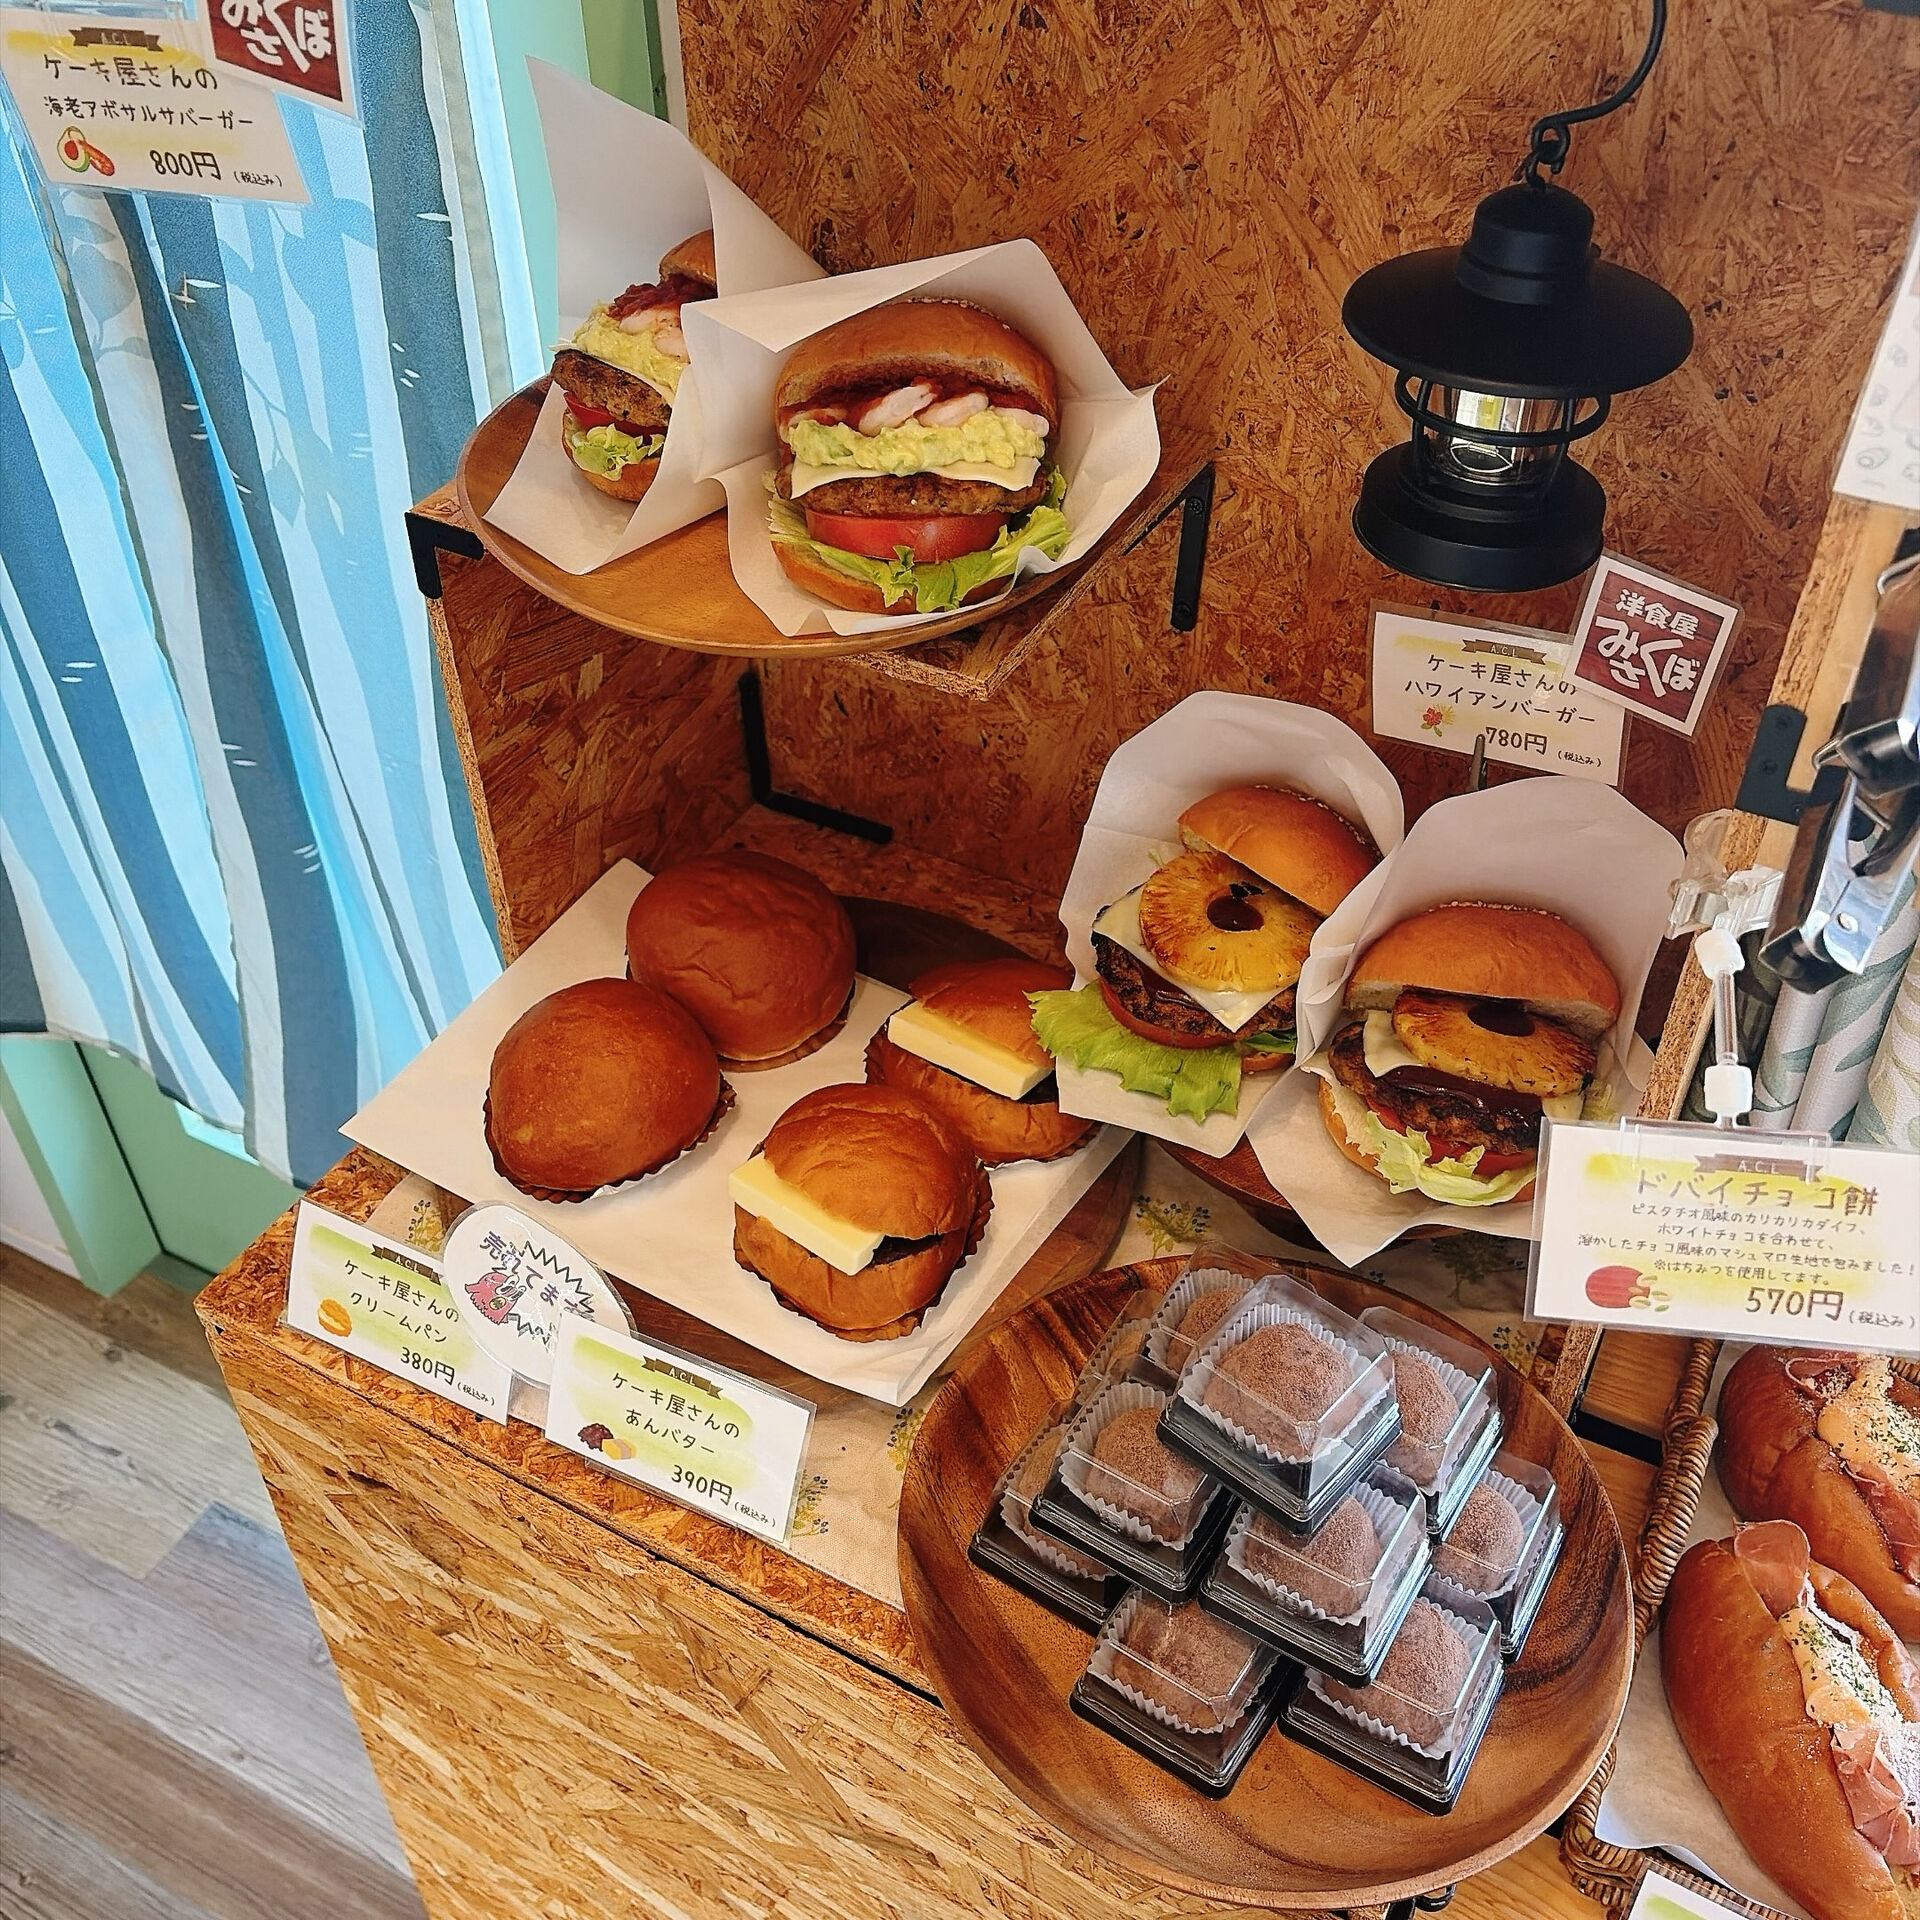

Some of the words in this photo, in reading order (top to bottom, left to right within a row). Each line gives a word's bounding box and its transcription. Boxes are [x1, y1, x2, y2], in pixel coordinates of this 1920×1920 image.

[43, 54, 218, 90] ケーキ屋さんの
[43, 95, 254, 130] 海老アボサルサバーガー
[150, 149, 222, 181] 800円
[233, 170, 283, 188] (税込み)
[1615, 588, 1699, 640] 洋食屋
[1427, 653, 1577, 696] ケーキ屋さんの
[1404, 680, 1596, 724] ハワイアンバーガー
[1485, 726, 1549, 755] 780円
[1556, 750, 1602, 768] (税込み)
[1637, 1169, 1879, 1216] ドバイチョコ餅
[1657, 1223, 1834, 1250] ホワイトチョコを合わせて、
[344, 1259, 460, 1323] ケーキ屋さんの
[1745, 1286, 1844, 1321] 570円
[1848, 1310, 1916, 1329] (税込み)
[350, 1292, 447, 1343] クリームパン
[400, 1346, 455, 1386] 380円
[457, 1381, 495, 1406] (税込み)
[612, 1372, 741, 1439] ケーキ屋さんの
[625, 1407, 715, 1454] あんバター
[671, 1464, 733, 1507] 390円
[734, 1502, 776, 1527] (税込み)
